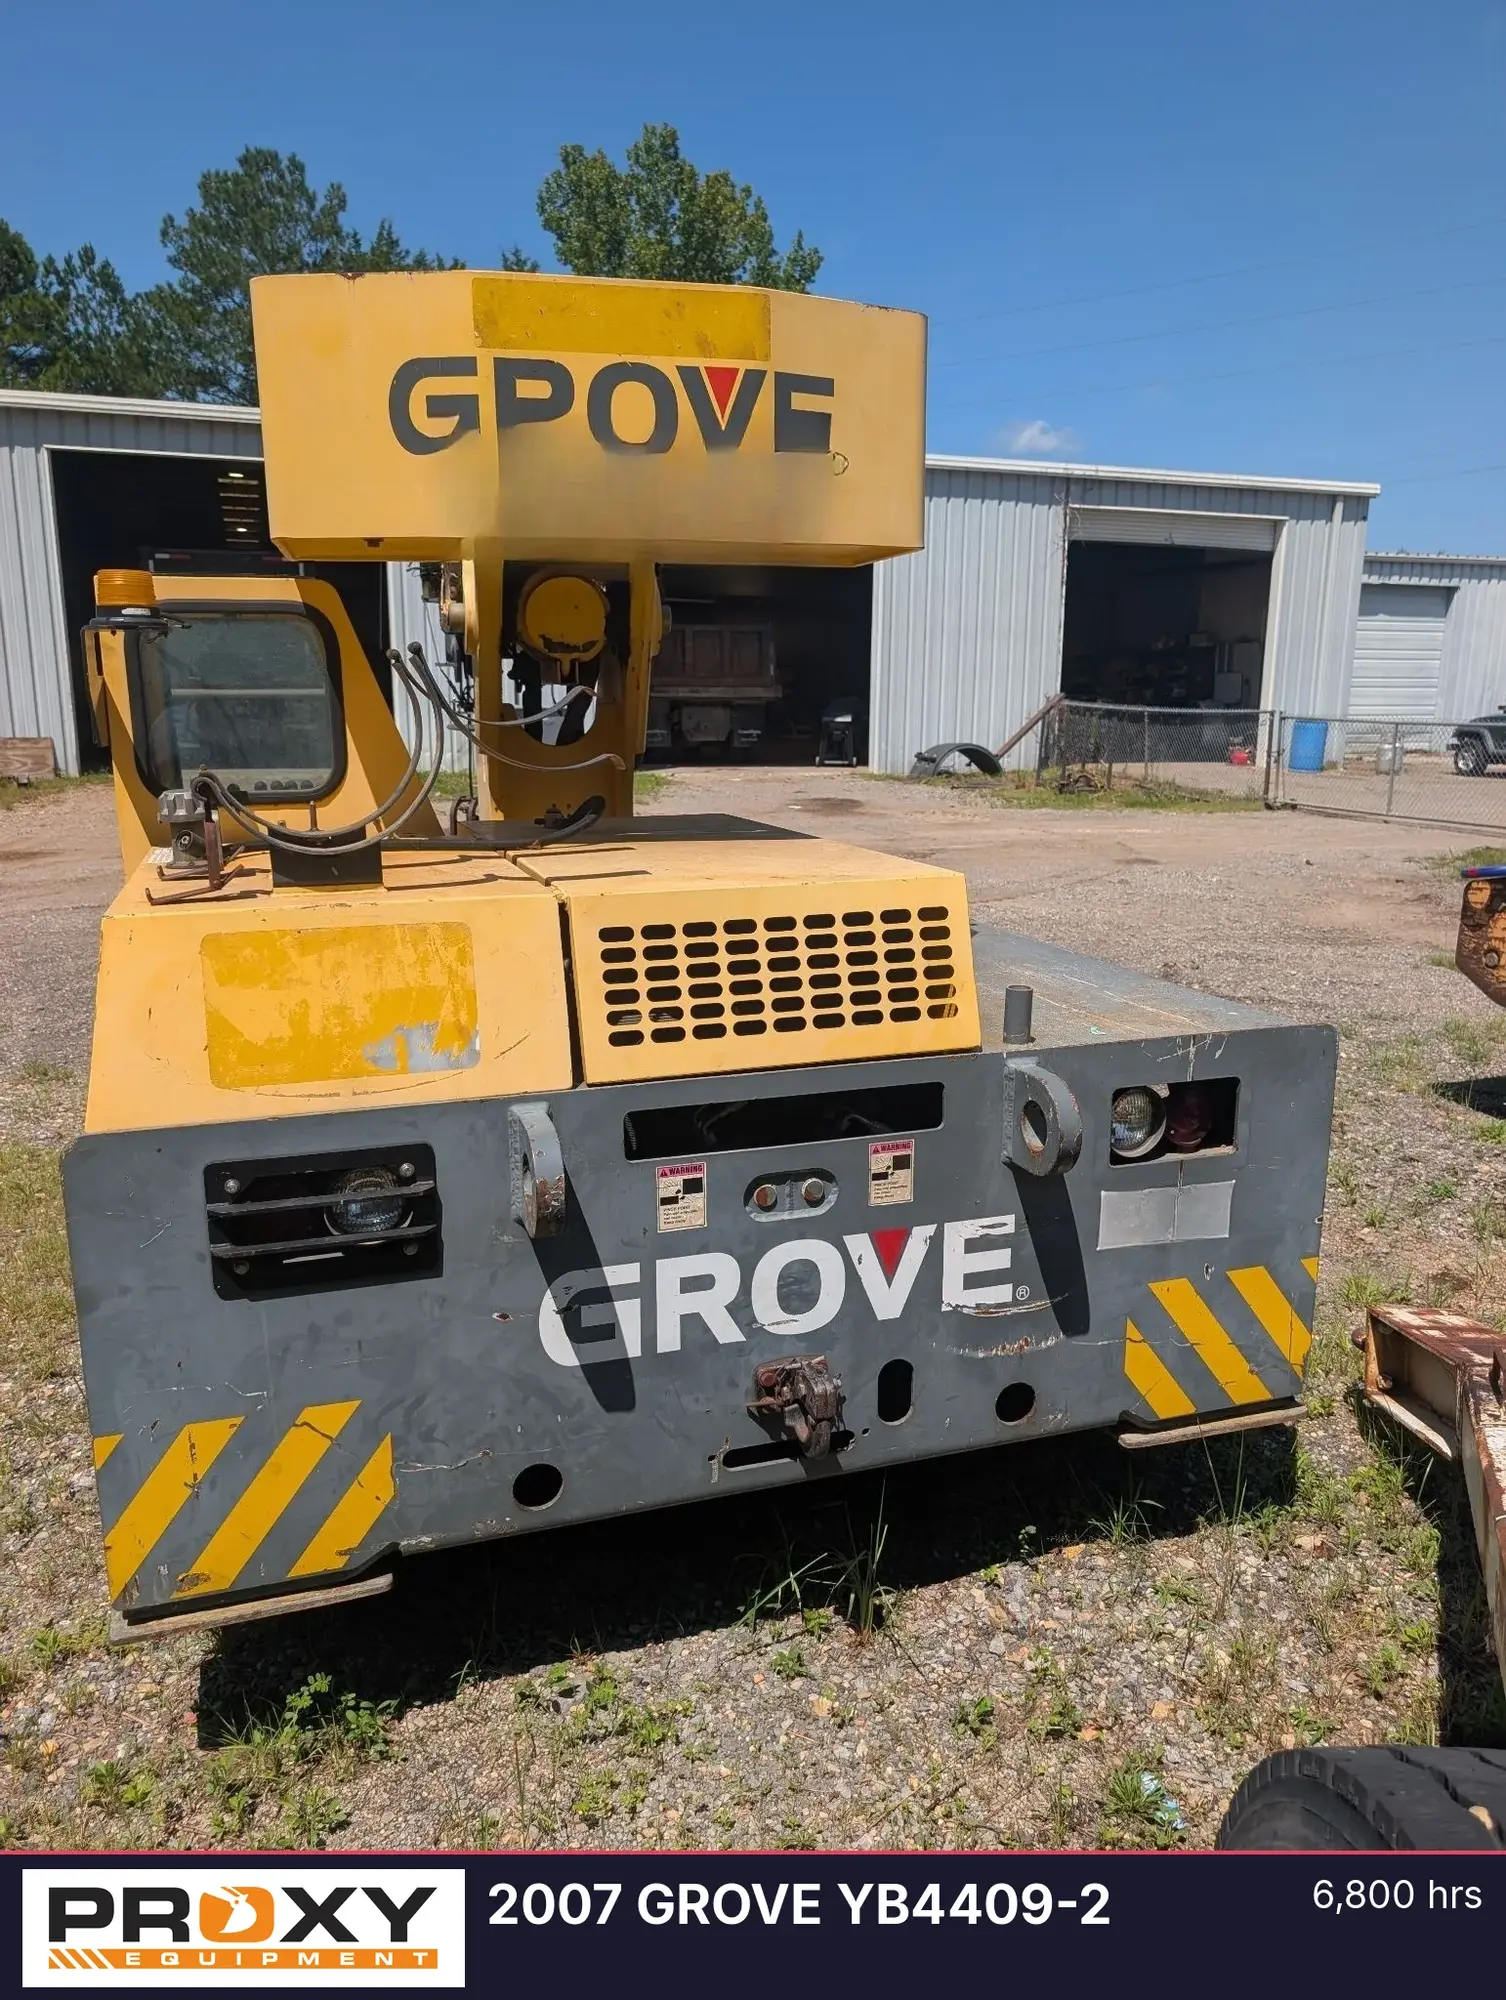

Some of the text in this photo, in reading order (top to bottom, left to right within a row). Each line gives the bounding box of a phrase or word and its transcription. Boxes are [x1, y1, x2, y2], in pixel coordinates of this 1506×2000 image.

[881, 1142, 911, 1152] WARNING
[669, 1164, 703, 1176] WARNING
[538, 1214, 1016, 1366] GROVE
